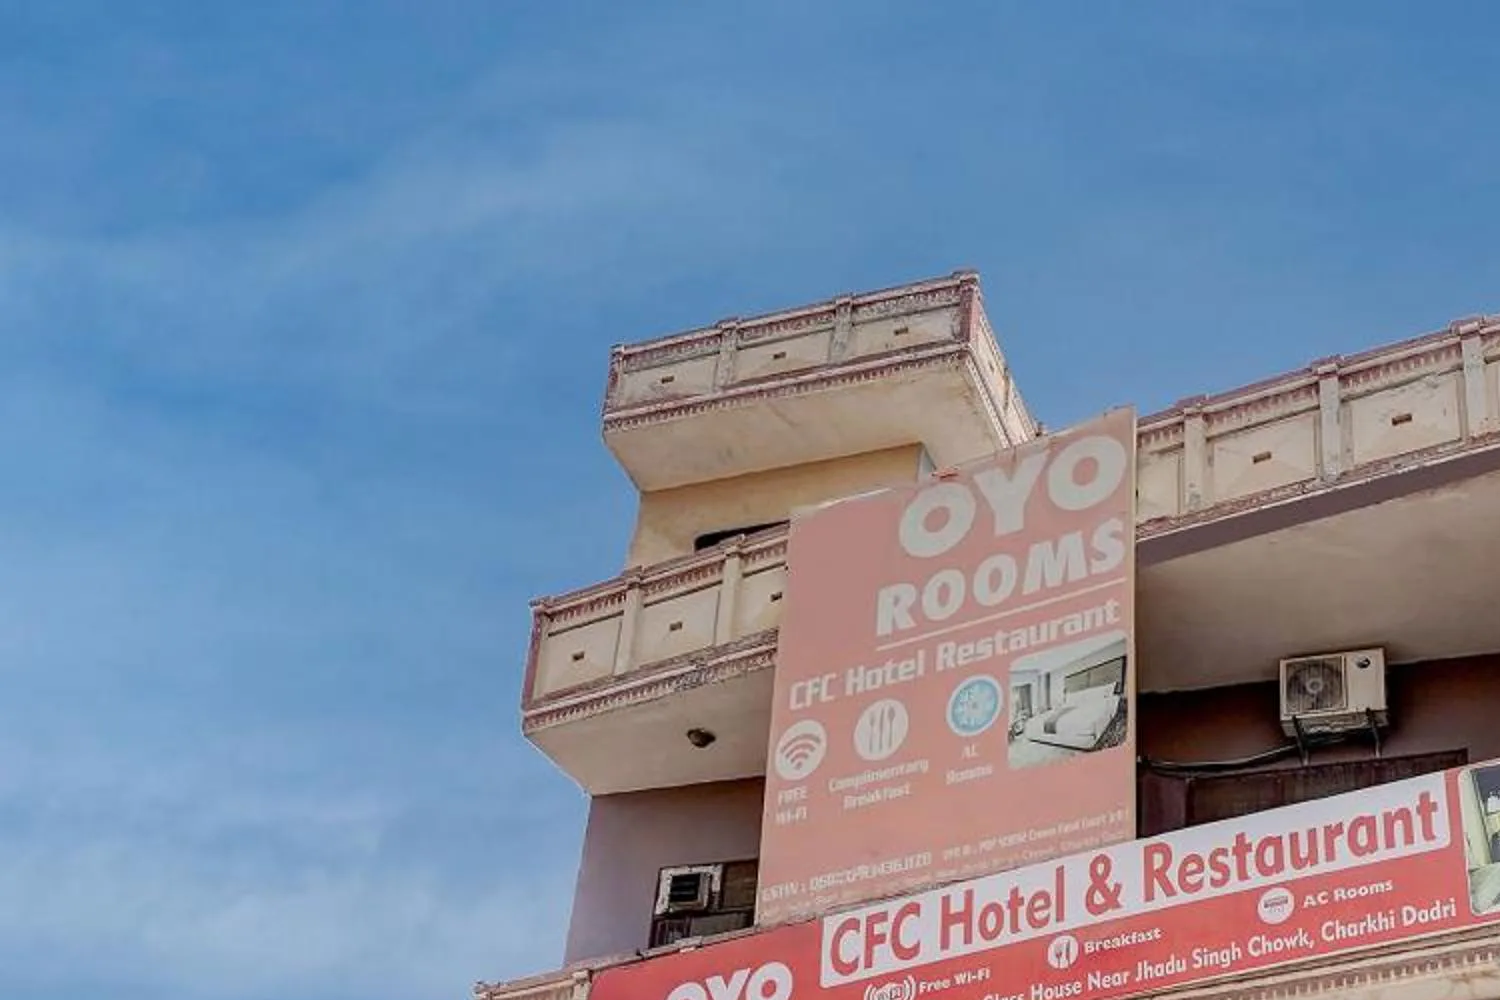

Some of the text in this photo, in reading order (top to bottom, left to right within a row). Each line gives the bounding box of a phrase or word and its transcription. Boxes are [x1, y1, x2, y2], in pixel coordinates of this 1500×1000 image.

[899, 435, 1128, 558] OYO
[876, 516, 1127, 636] ROOMS
[789, 600, 1122, 711] CFC Hotel Restaurant
[829, 900, 921, 976] CFC
[939, 863, 1065, 951] Hotel
[1084, 853, 1123, 917] &
[1144, 791, 1439, 902] Restaurant
[1301, 888, 1330, 909] AC
[1333, 878, 1394, 901] Rooms
[1083, 926, 1162, 956] Breakfast
[1087, 966, 1132, 991] Near
[1134, 954, 1188, 982] Jhadu
[1192, 943, 1242, 974] Singh
[1320, 912, 1396, 942] Charkhi
[1401, 897, 1456, 928] Dadri
